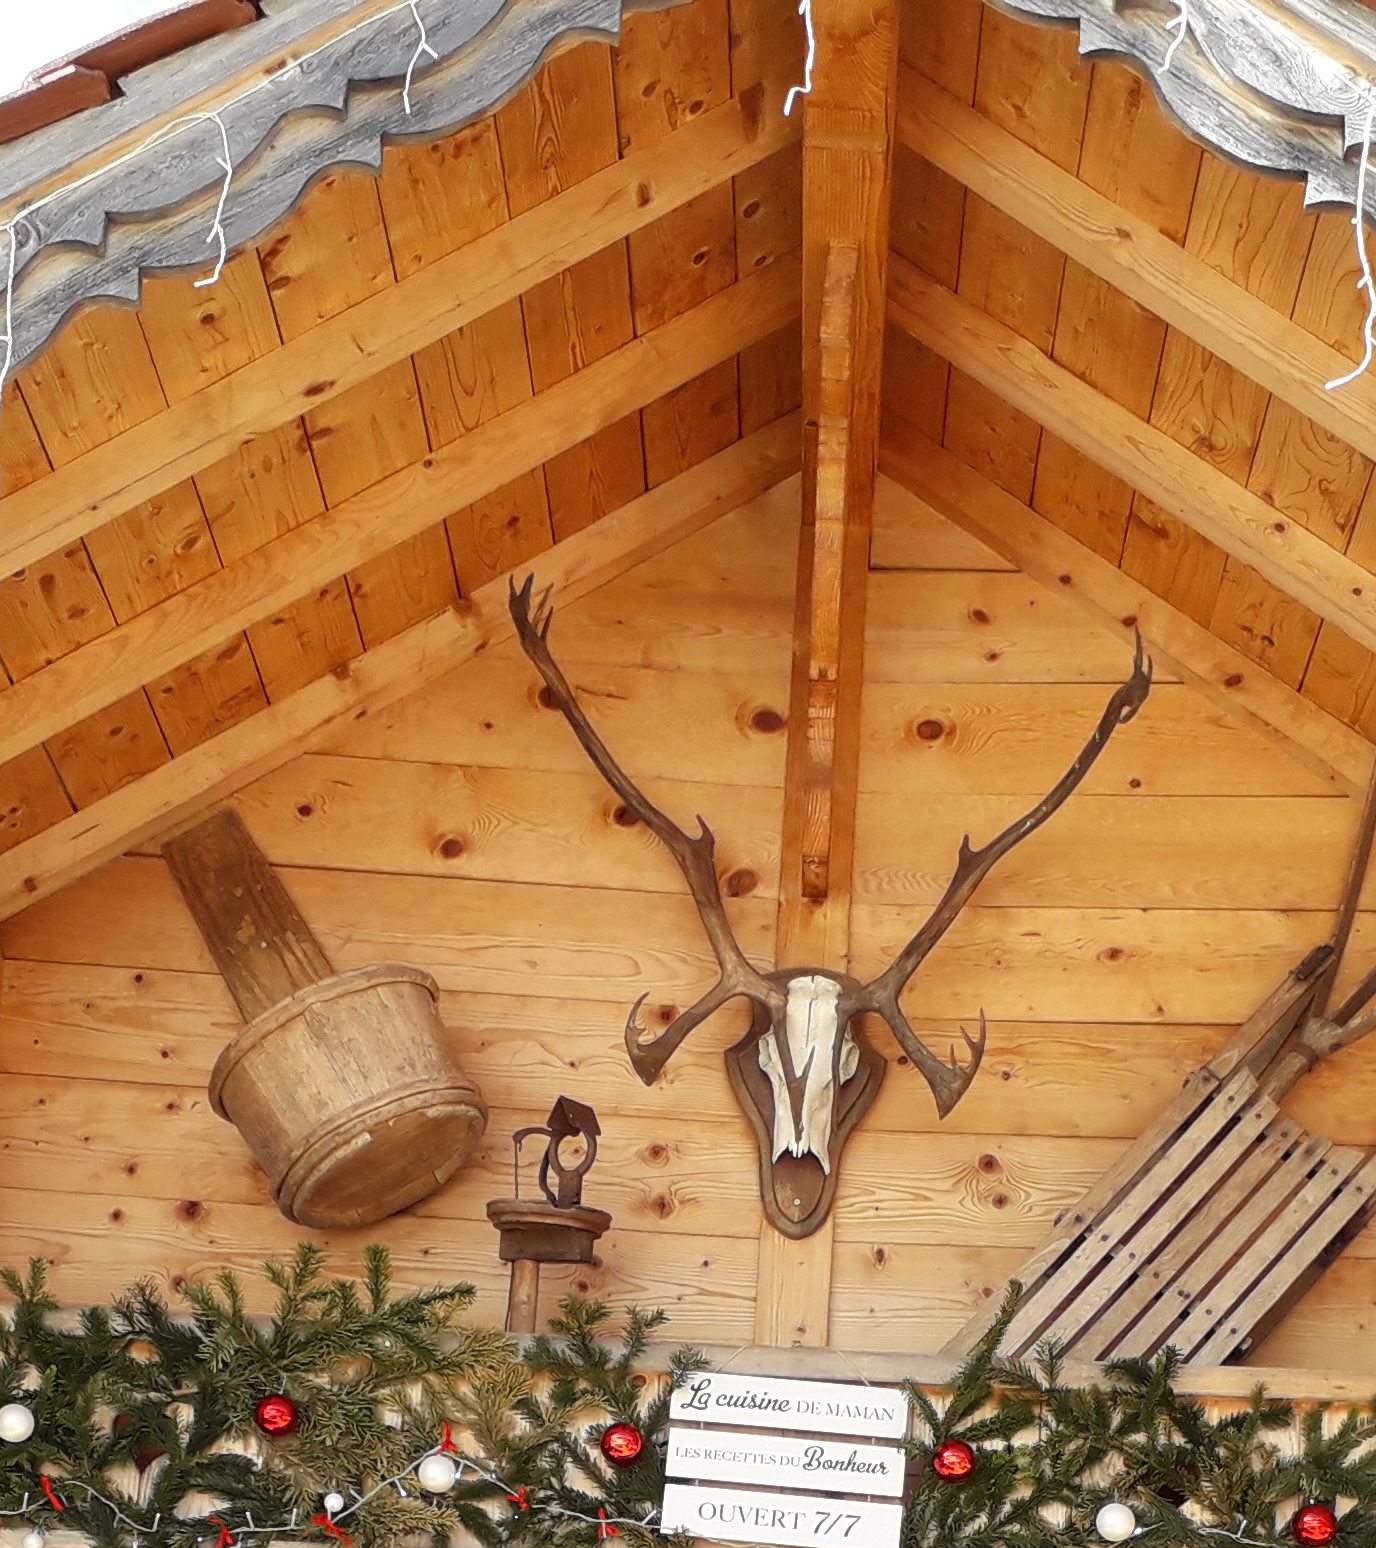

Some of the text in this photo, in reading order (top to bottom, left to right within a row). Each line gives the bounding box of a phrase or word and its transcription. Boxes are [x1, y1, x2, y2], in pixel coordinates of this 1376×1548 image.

[680, 1378, 895, 1421] La cuisine DE MAMAN
[675, 1445, 890, 1475] LES RECETTES DU Bonheur
[698, 1502, 862, 1538] OUVERT 7/7
